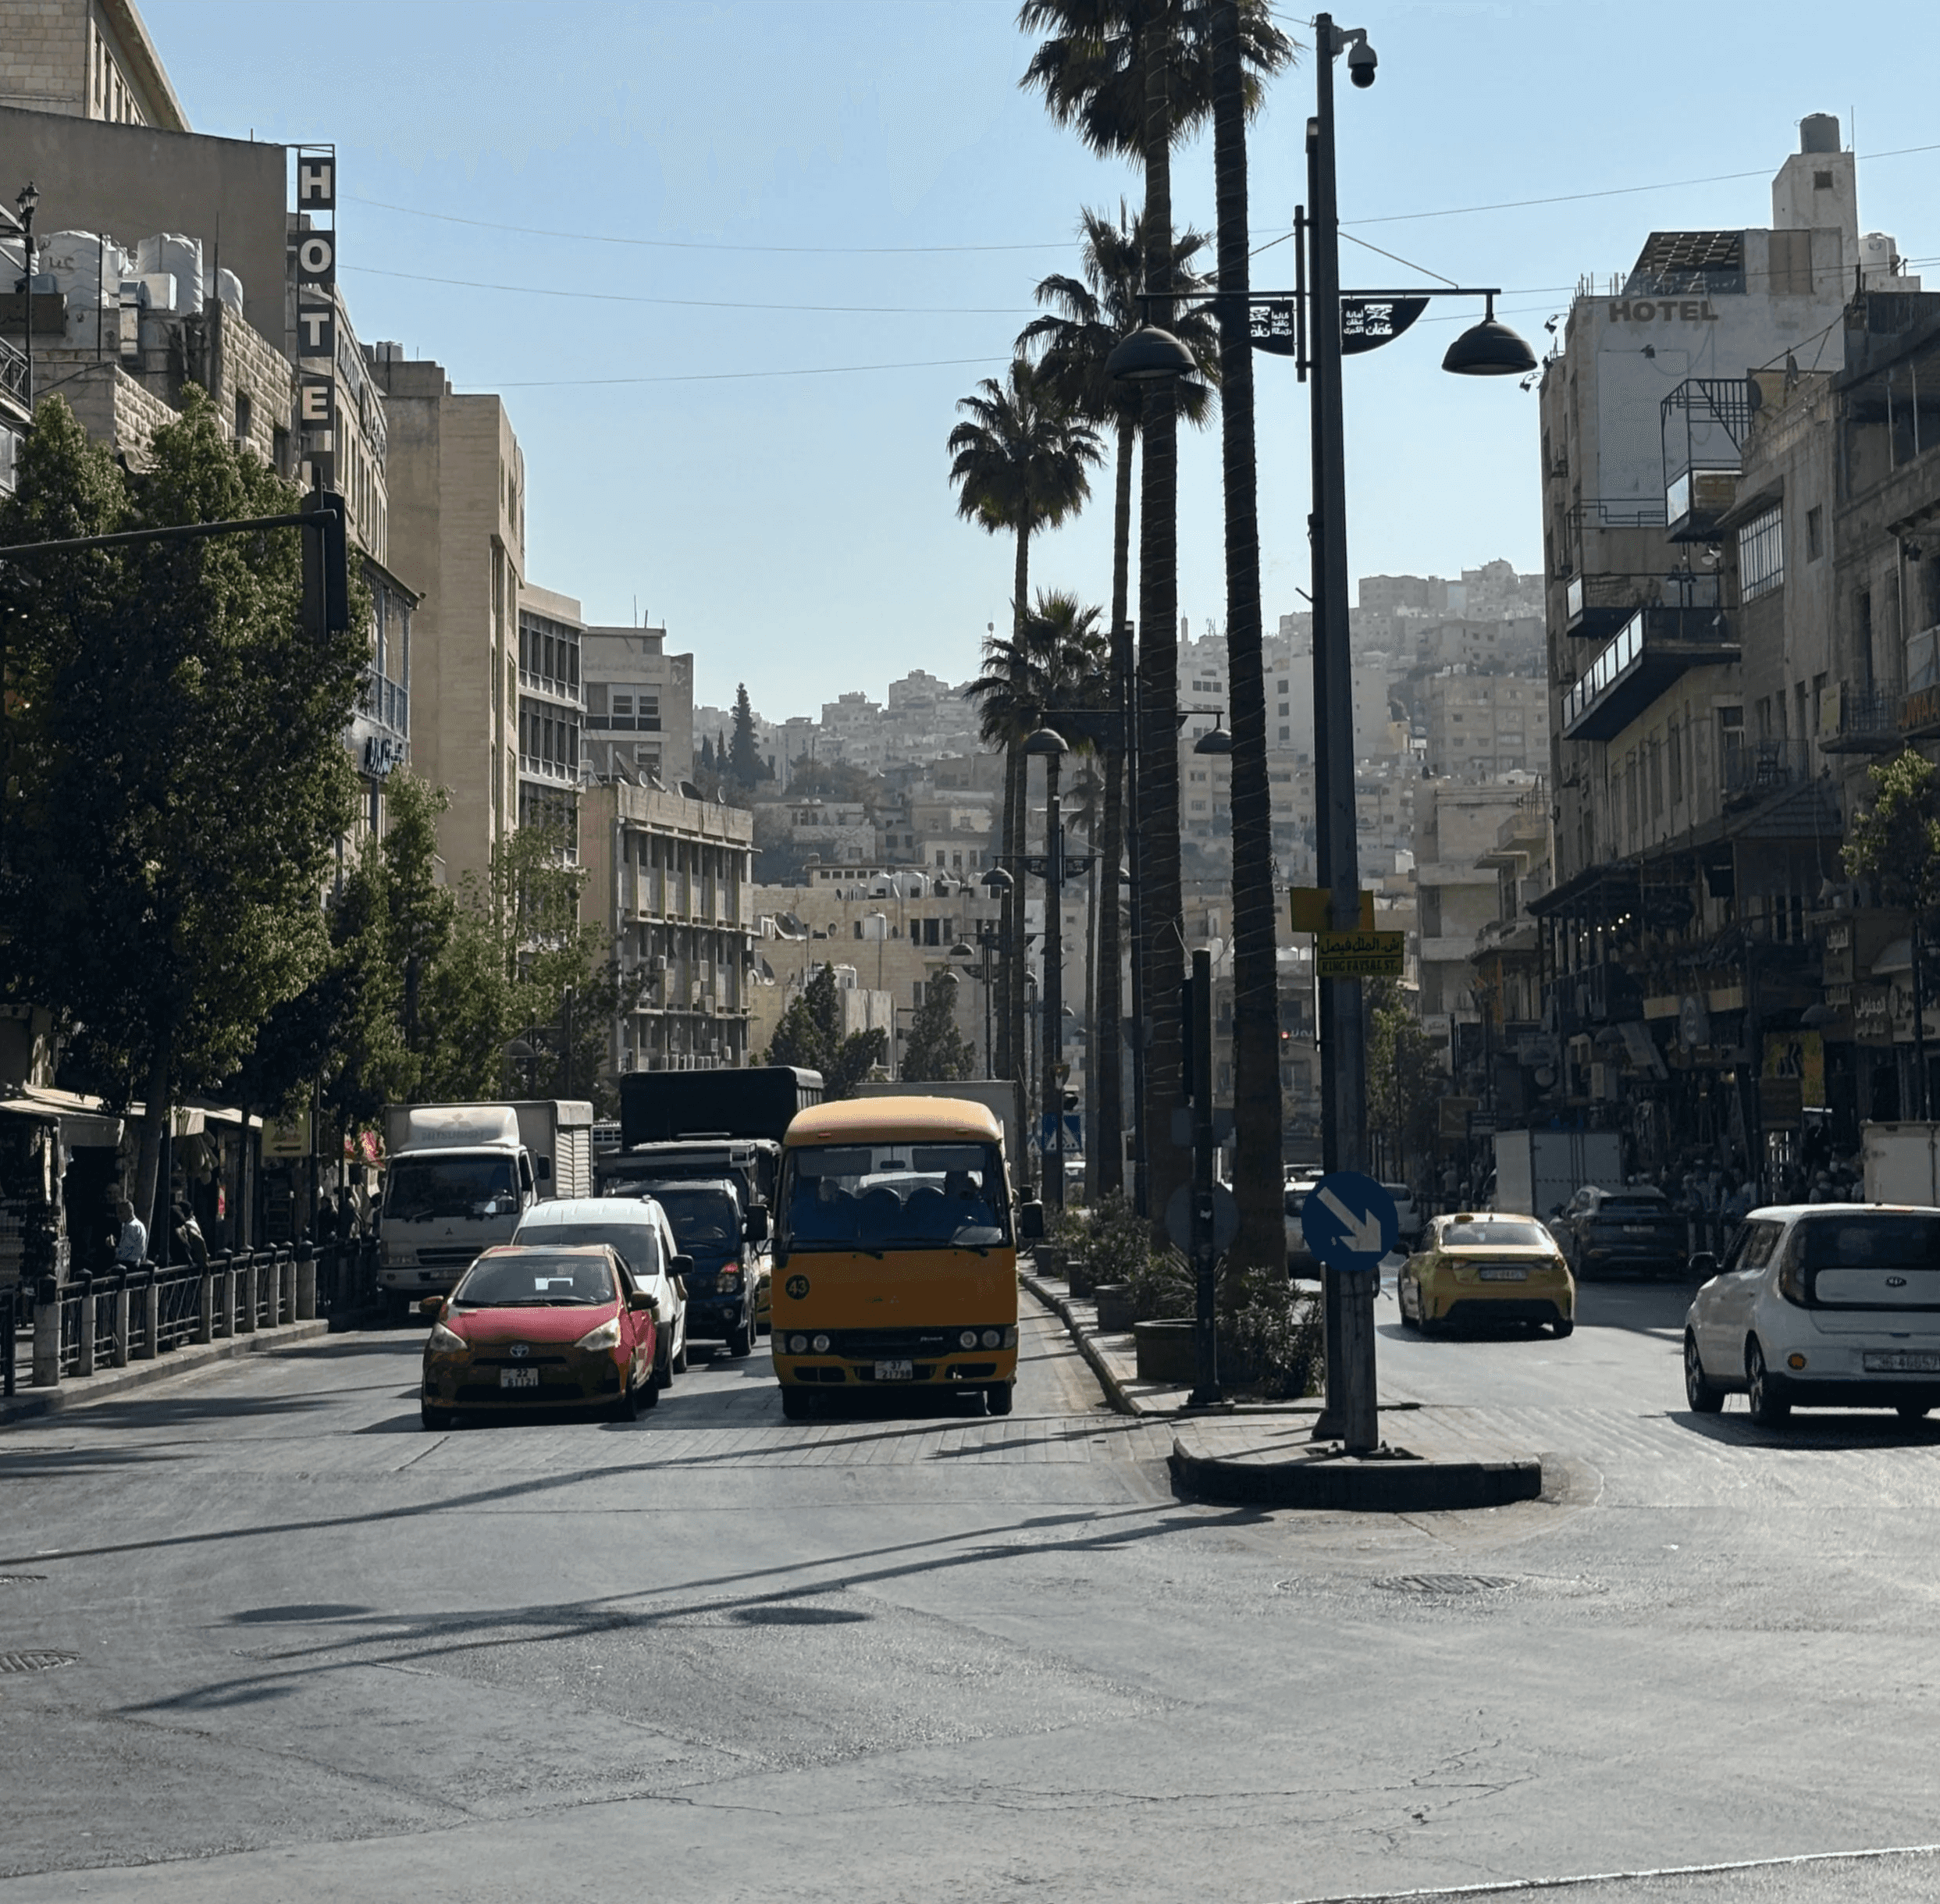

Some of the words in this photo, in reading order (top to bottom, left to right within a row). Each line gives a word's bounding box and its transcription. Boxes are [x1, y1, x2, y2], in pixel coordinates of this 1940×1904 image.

[1609, 301, 1718, 322] HOTEL
[299, 165, 333, 492] HOTEL
[1321, 937, 1351, 955] فيصل
[1352, 936, 1379, 952] الملك
[1322, 960, 1345, 972] KING
[788, 1280, 806, 1294] 43
[517, 1368, 529, 1377] 22
